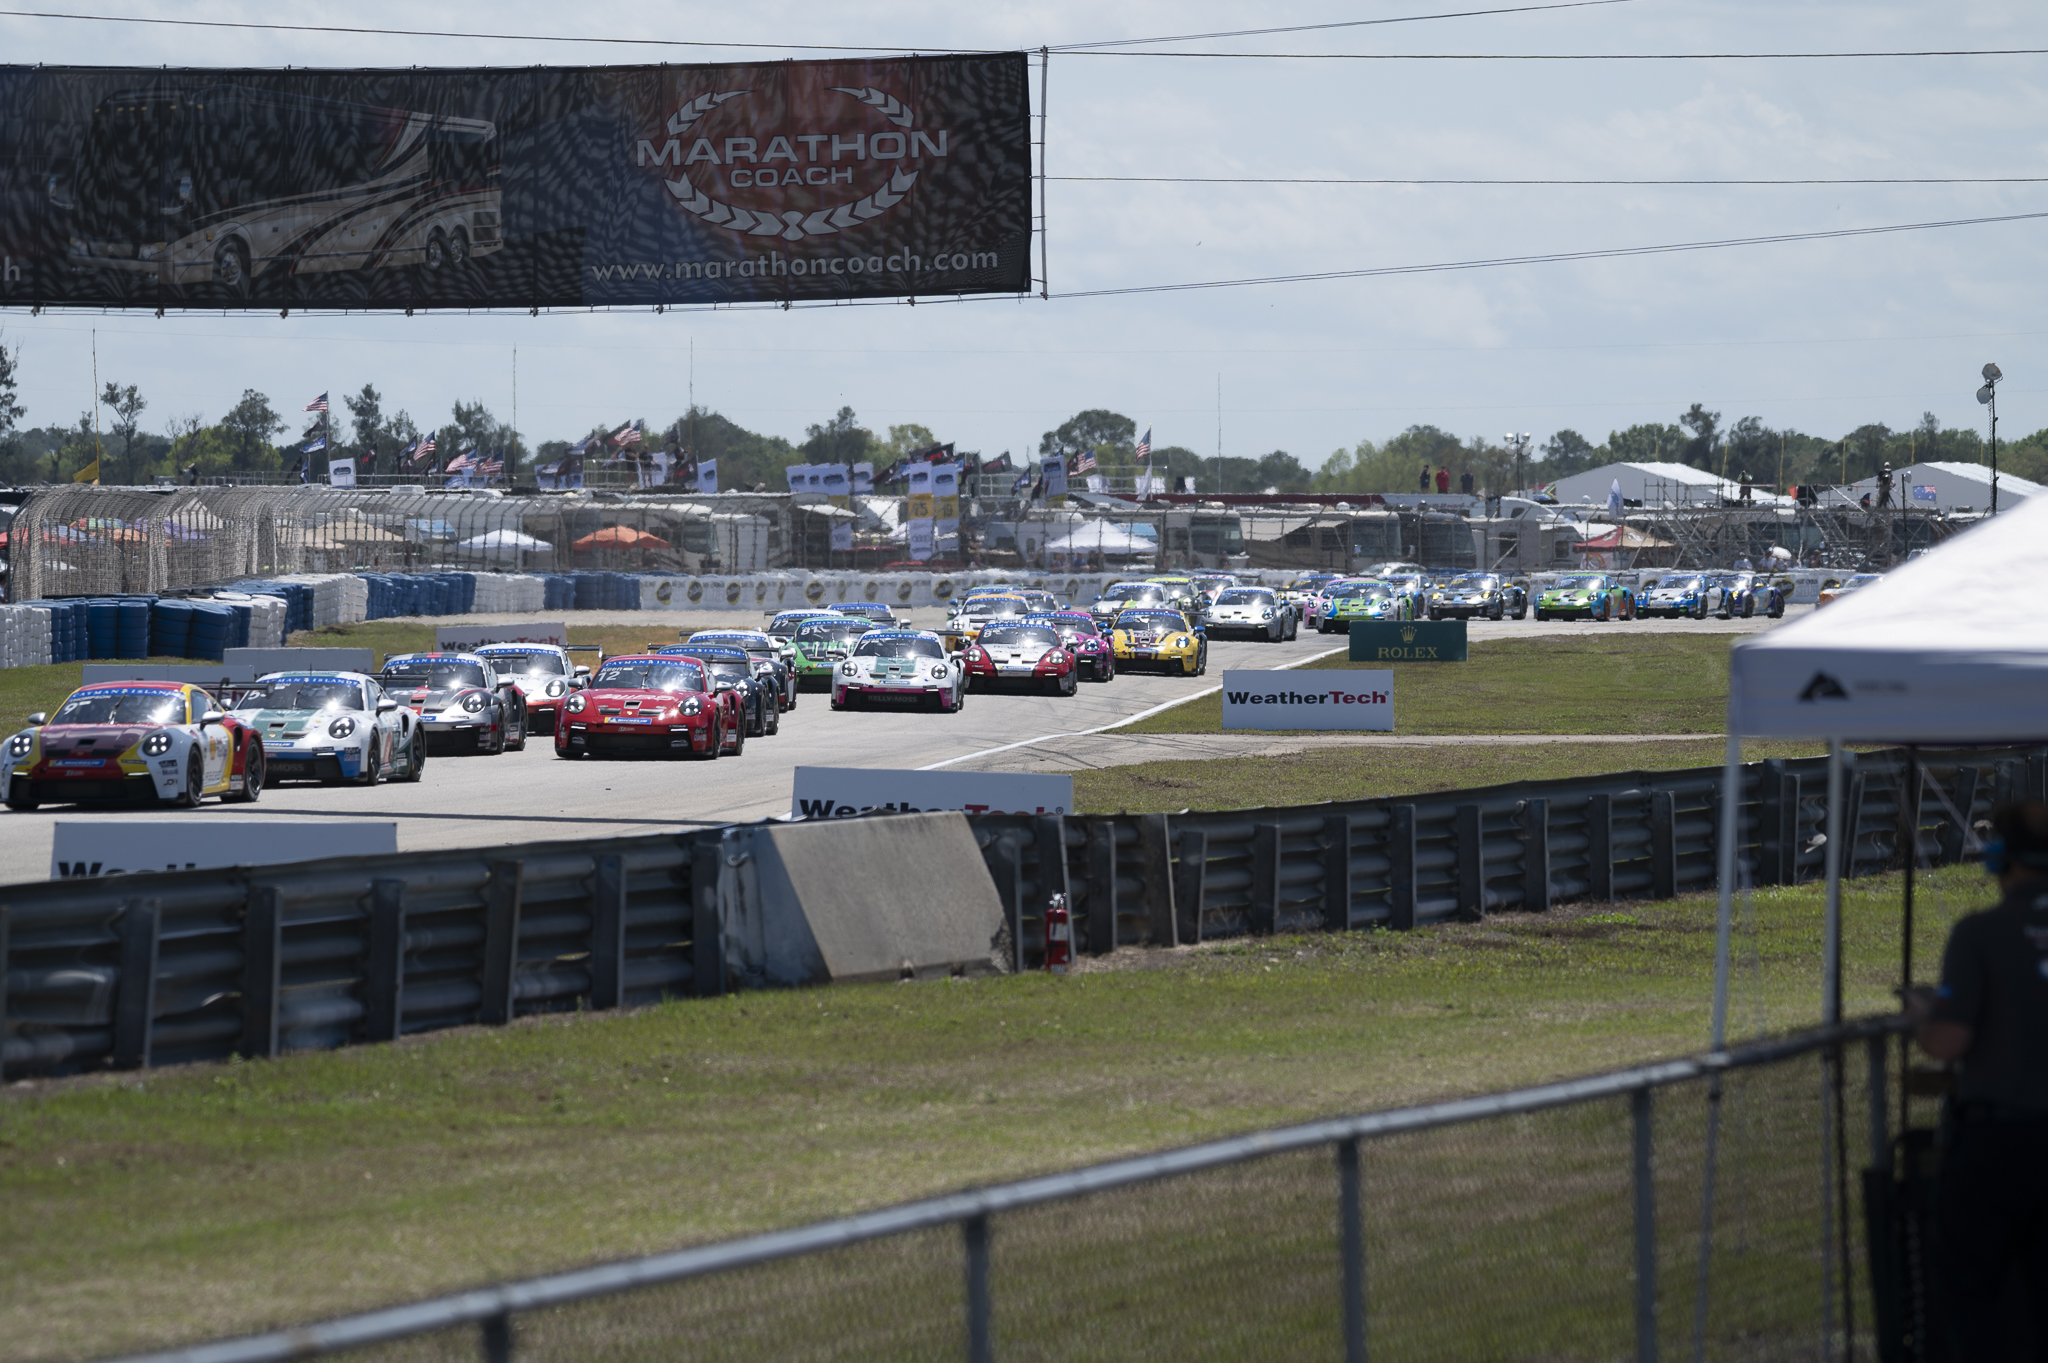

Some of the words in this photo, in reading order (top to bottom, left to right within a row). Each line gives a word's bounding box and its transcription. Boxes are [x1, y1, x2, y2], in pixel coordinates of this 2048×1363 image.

[637, 130, 948, 167] MARATHON
[730, 166, 853, 188] COACH
[591, 247, 998, 281] www.marathoncoach.com
[1377, 647, 1438, 659] ROLEX
[656, 660, 698, 669] ISLANDS
[598, 671, 620, 682] 12
